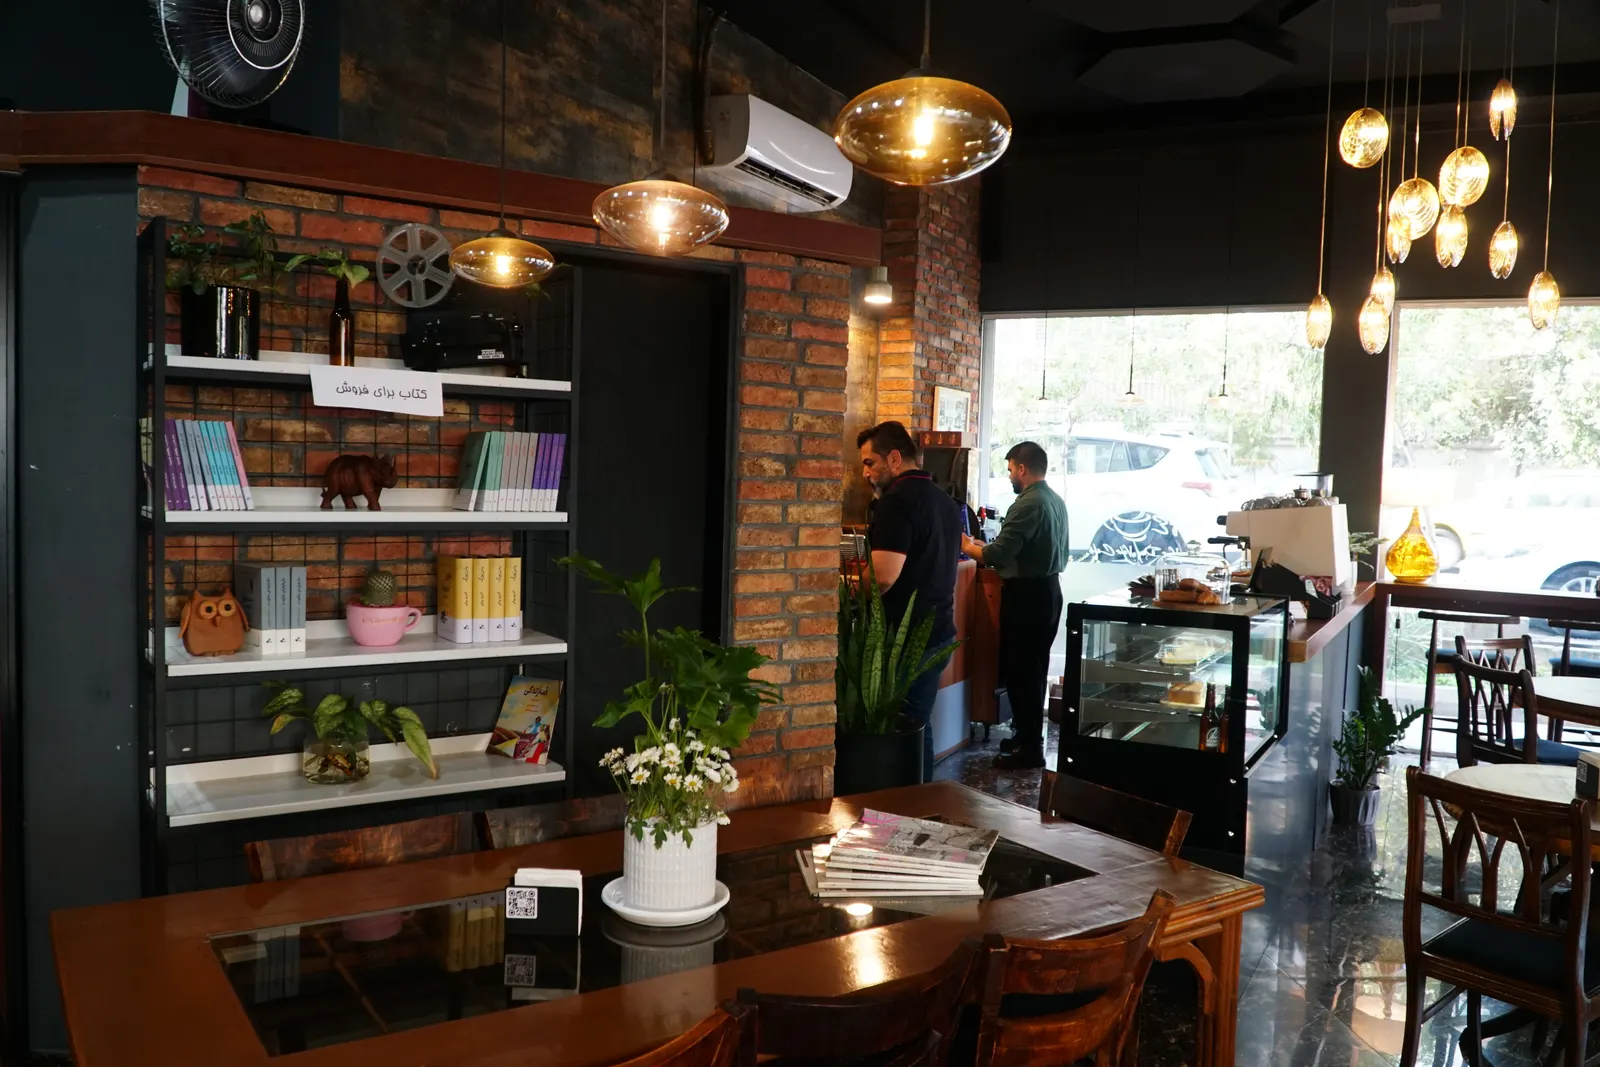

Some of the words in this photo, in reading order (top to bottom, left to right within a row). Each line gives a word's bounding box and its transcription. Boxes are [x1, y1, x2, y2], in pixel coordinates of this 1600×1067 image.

[335, 380, 369, 396] فروش
[373, 385, 395, 399] برای
[398, 388, 428, 400] کتاب
